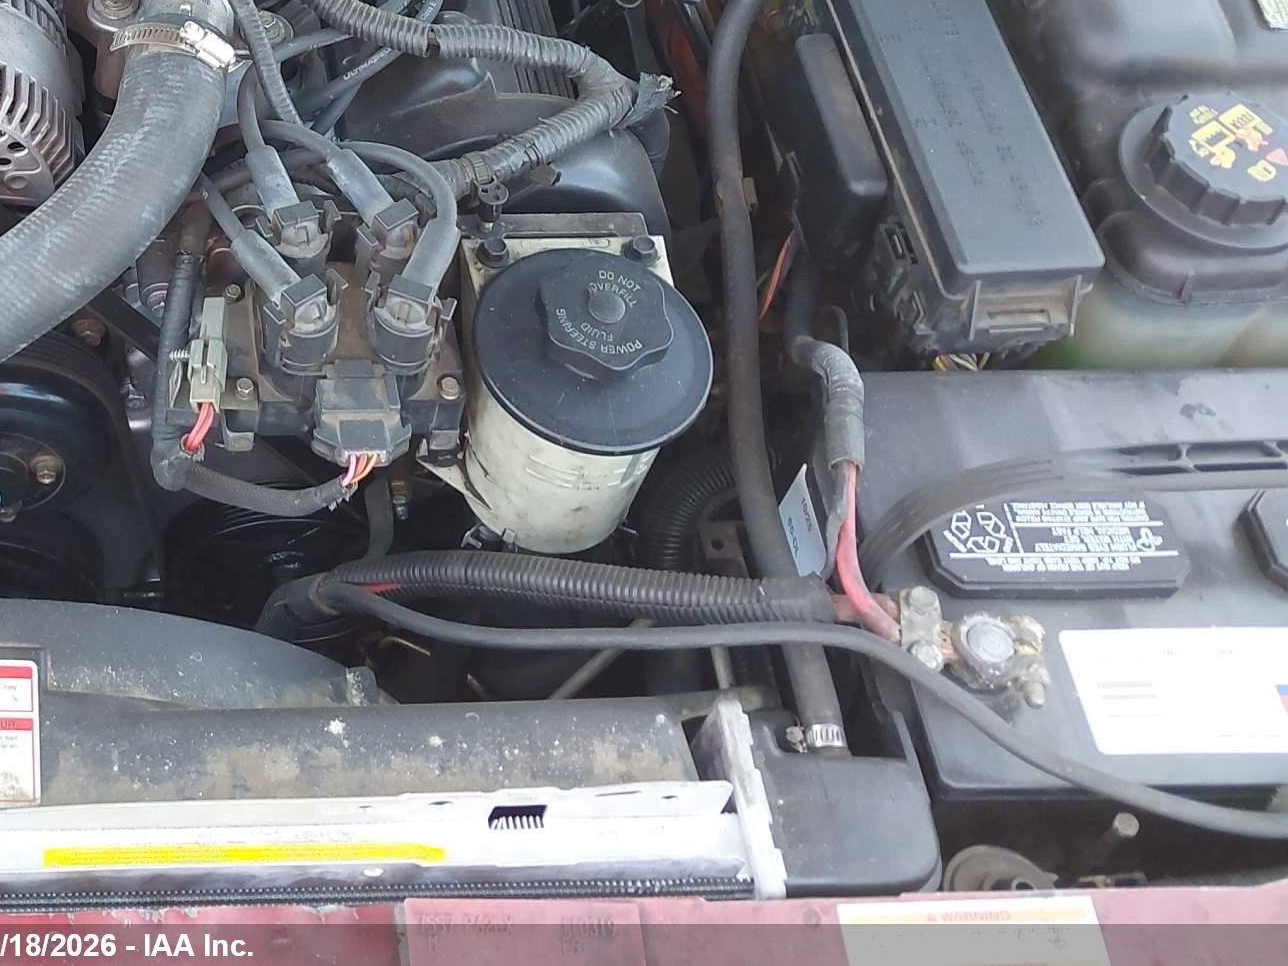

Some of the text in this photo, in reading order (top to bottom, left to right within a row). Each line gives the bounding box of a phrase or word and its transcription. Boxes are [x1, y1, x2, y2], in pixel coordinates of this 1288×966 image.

[598, 269, 641, 291] DO NOT
[588, 282, 637, 308] OVERFILL
[555, 307, 643, 355] POWER STEERING
[579, 321, 614, 342] FLUID
[940, 910, 1011, 923] WARNING
